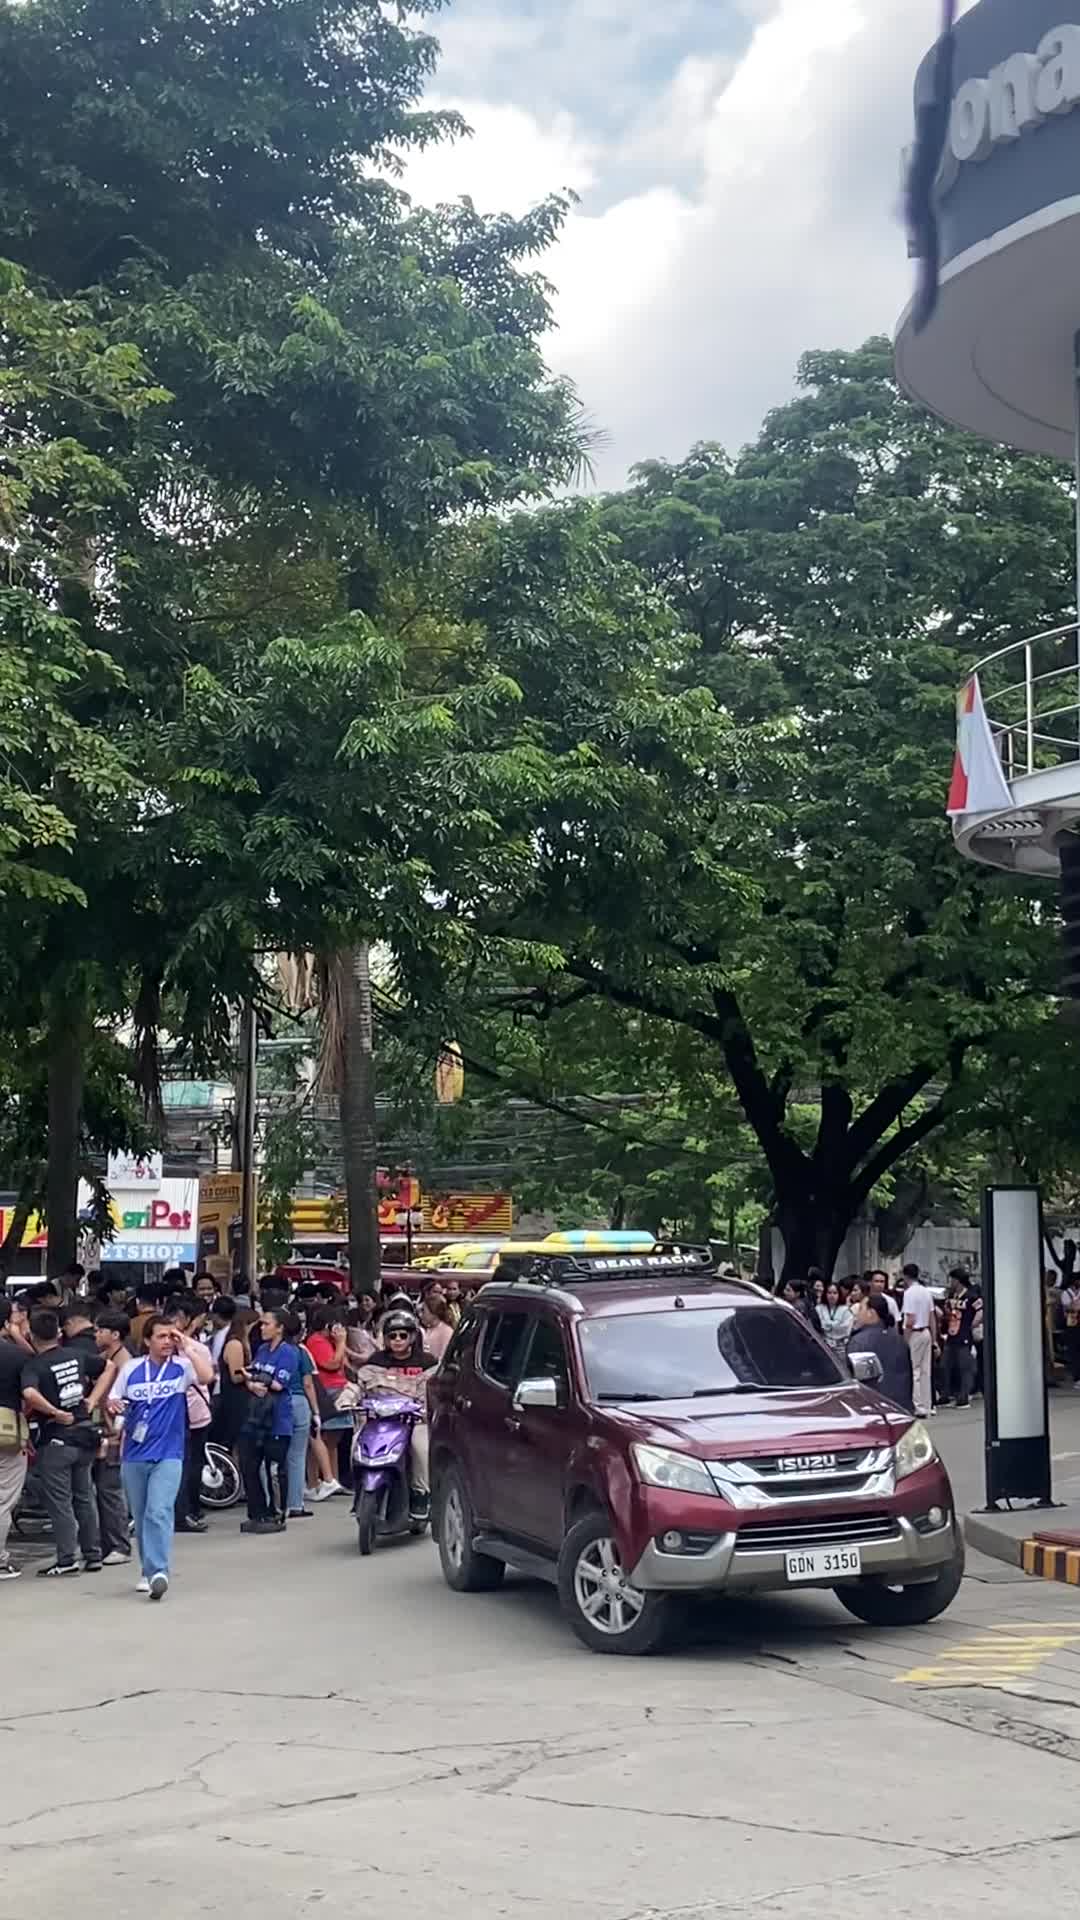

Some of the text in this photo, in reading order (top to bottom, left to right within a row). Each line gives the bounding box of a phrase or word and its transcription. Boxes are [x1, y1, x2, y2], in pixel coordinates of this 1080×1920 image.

[938, 24, 1080, 188] ona
[101, 1245, 184, 1260] ETSHOP
[594, 1254, 696, 1269] BEAR RACK
[778, 1454, 836, 1472] ISUZU
[789, 1552, 858, 1573] GDN 3150
